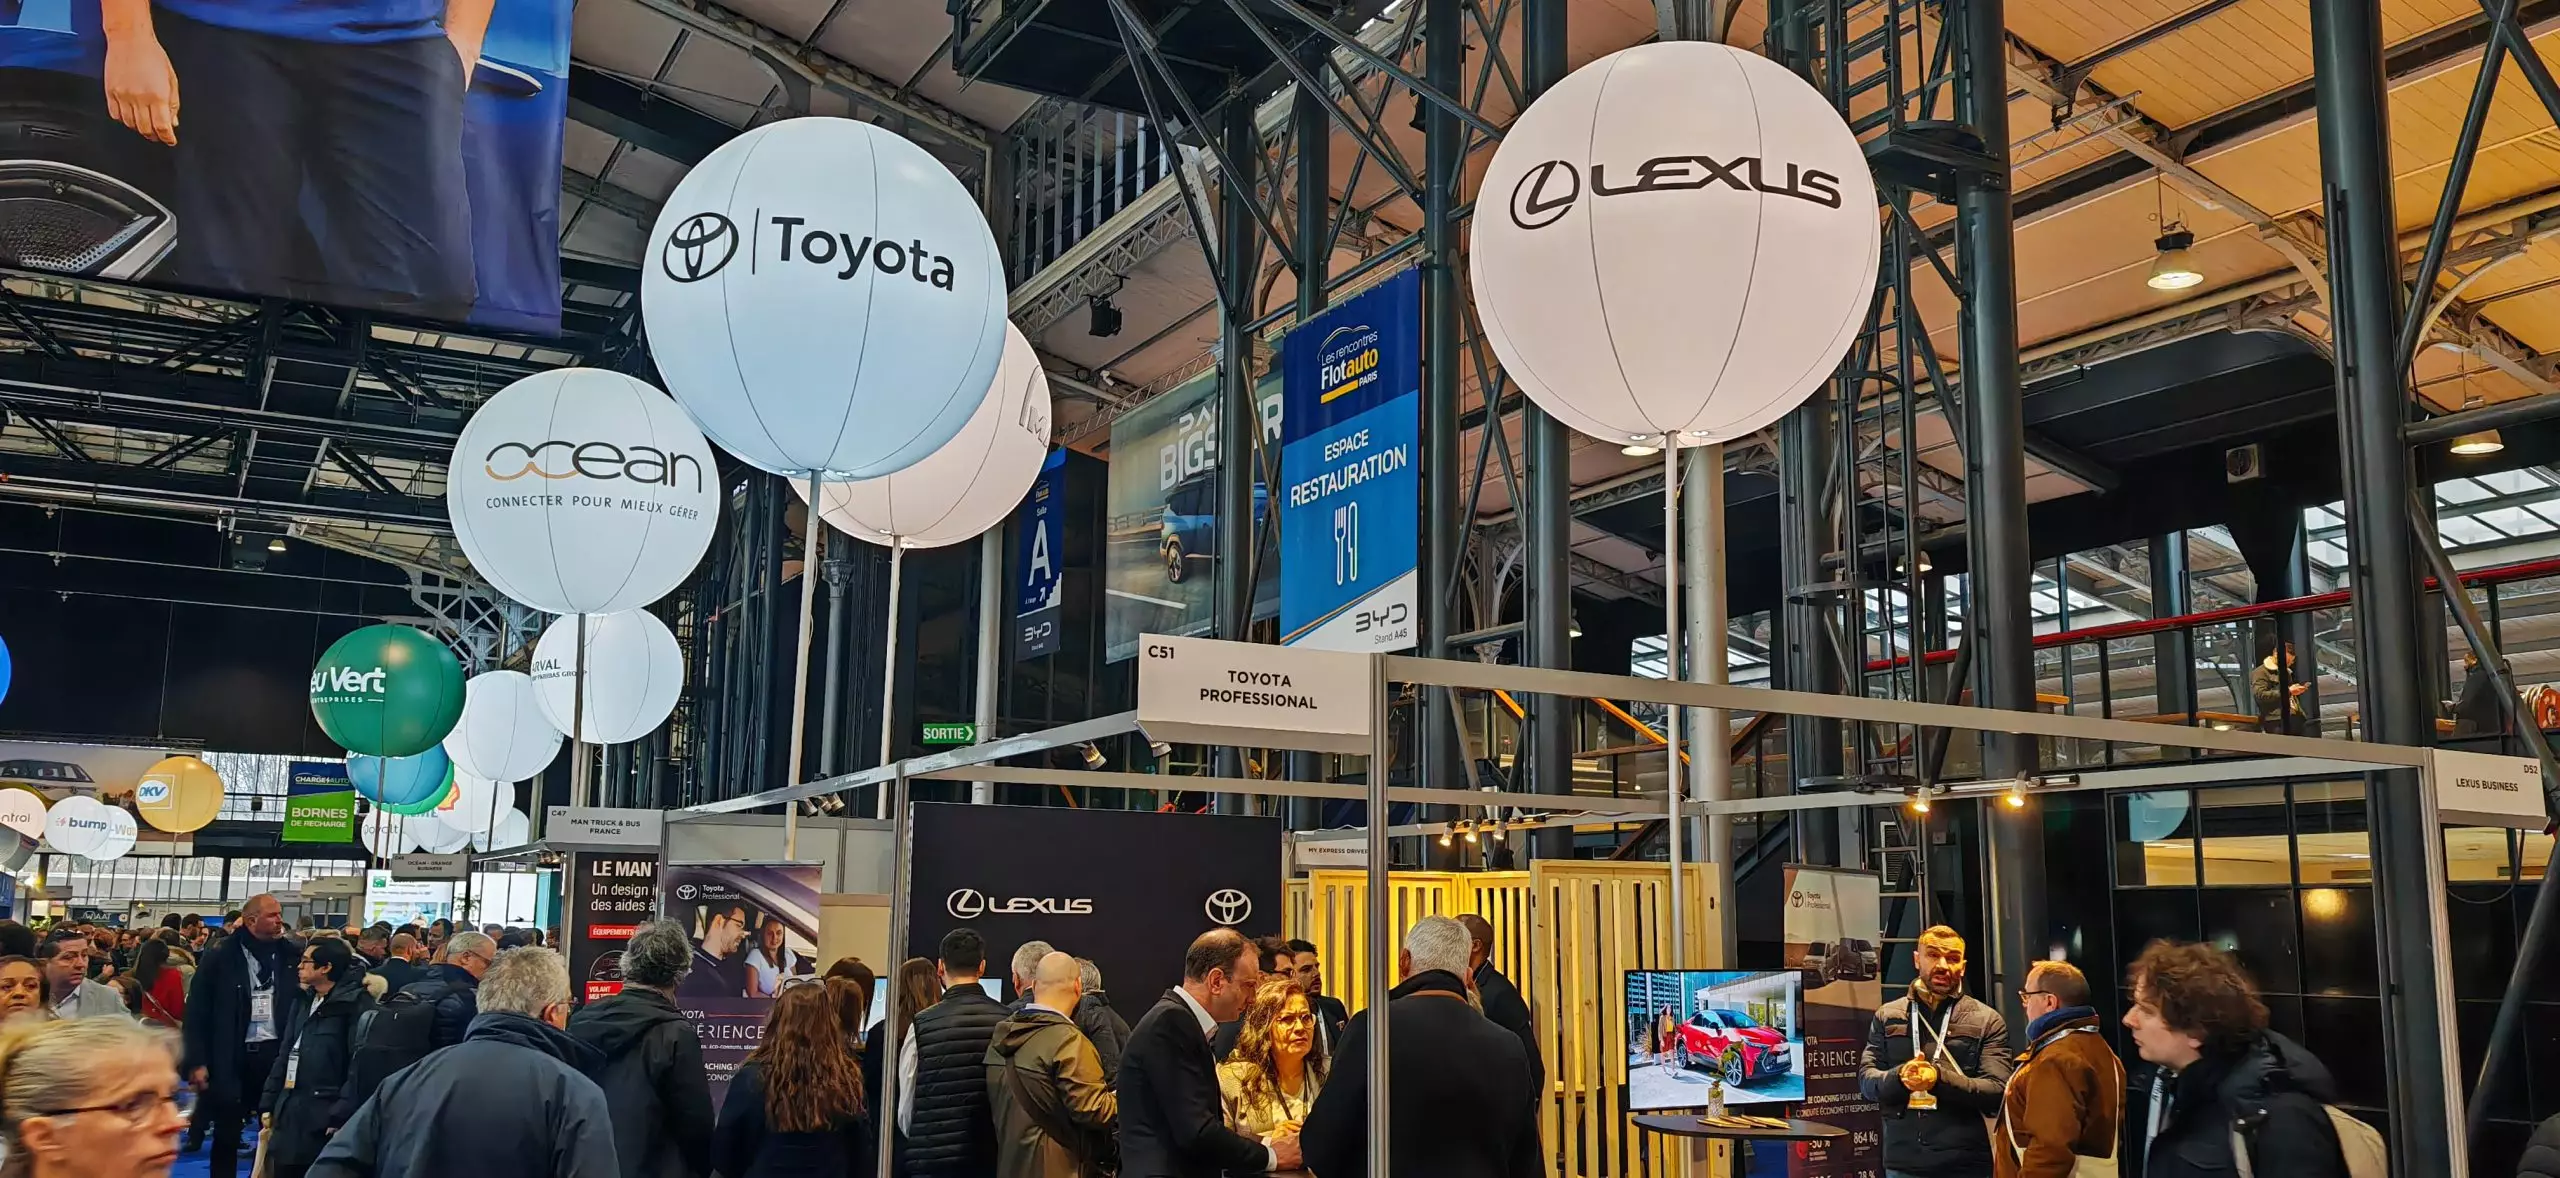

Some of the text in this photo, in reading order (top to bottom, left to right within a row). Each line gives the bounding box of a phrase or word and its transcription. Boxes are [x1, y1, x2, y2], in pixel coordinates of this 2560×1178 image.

[1590, 155, 1842, 210] LEXUS
[771, 216, 955, 292] Toyota
[1321, 330, 1378, 366] Les rencontres
[1321, 348, 1379, 390] Flotauto
[1358, 370, 1378, 387] PARIS
[1324, 428, 1369, 462] ESPACE
[485, 440, 702, 493] ocean
[1290, 443, 1407, 508] RESTAURATION
[486, 495, 699, 521] CONNECTER POUR MIEUX GÉRER
[1028, 519, 1052, 587] A
[1355, 602, 1408, 633] BYD
[1024, 621, 1052, 642] BYD
[1374, 627, 1408, 645] Stand A45
[1147, 645, 1175, 660] C51
[330, 666, 387, 693] Vert
[1227, 670, 1292, 688] TOYOTA
[1200, 688, 1318, 710] PROFESSIONAL
[923, 727, 965, 740] SORTIE
[2523, 764, 2539, 775] D52
[2456, 777, 2519, 792] LEXUS BUSINESS
[292, 807, 348, 819] BORNES
[68, 817, 107, 832] bump
[592, 861, 612, 877] LE
[615, 861, 652, 877] MAN
[591, 883, 608, 896] Un
[610, 883, 649, 899] design
[702, 884, 725, 892] Toyota
[1807, 891, 1821, 901] Toyota
[590, 899, 656, 911] des aides à
[988, 897, 1093, 914] LEXUS
[1805, 1036, 1818, 1046] OTA
[1853, 1131, 1879, 1146] 864 Kg
